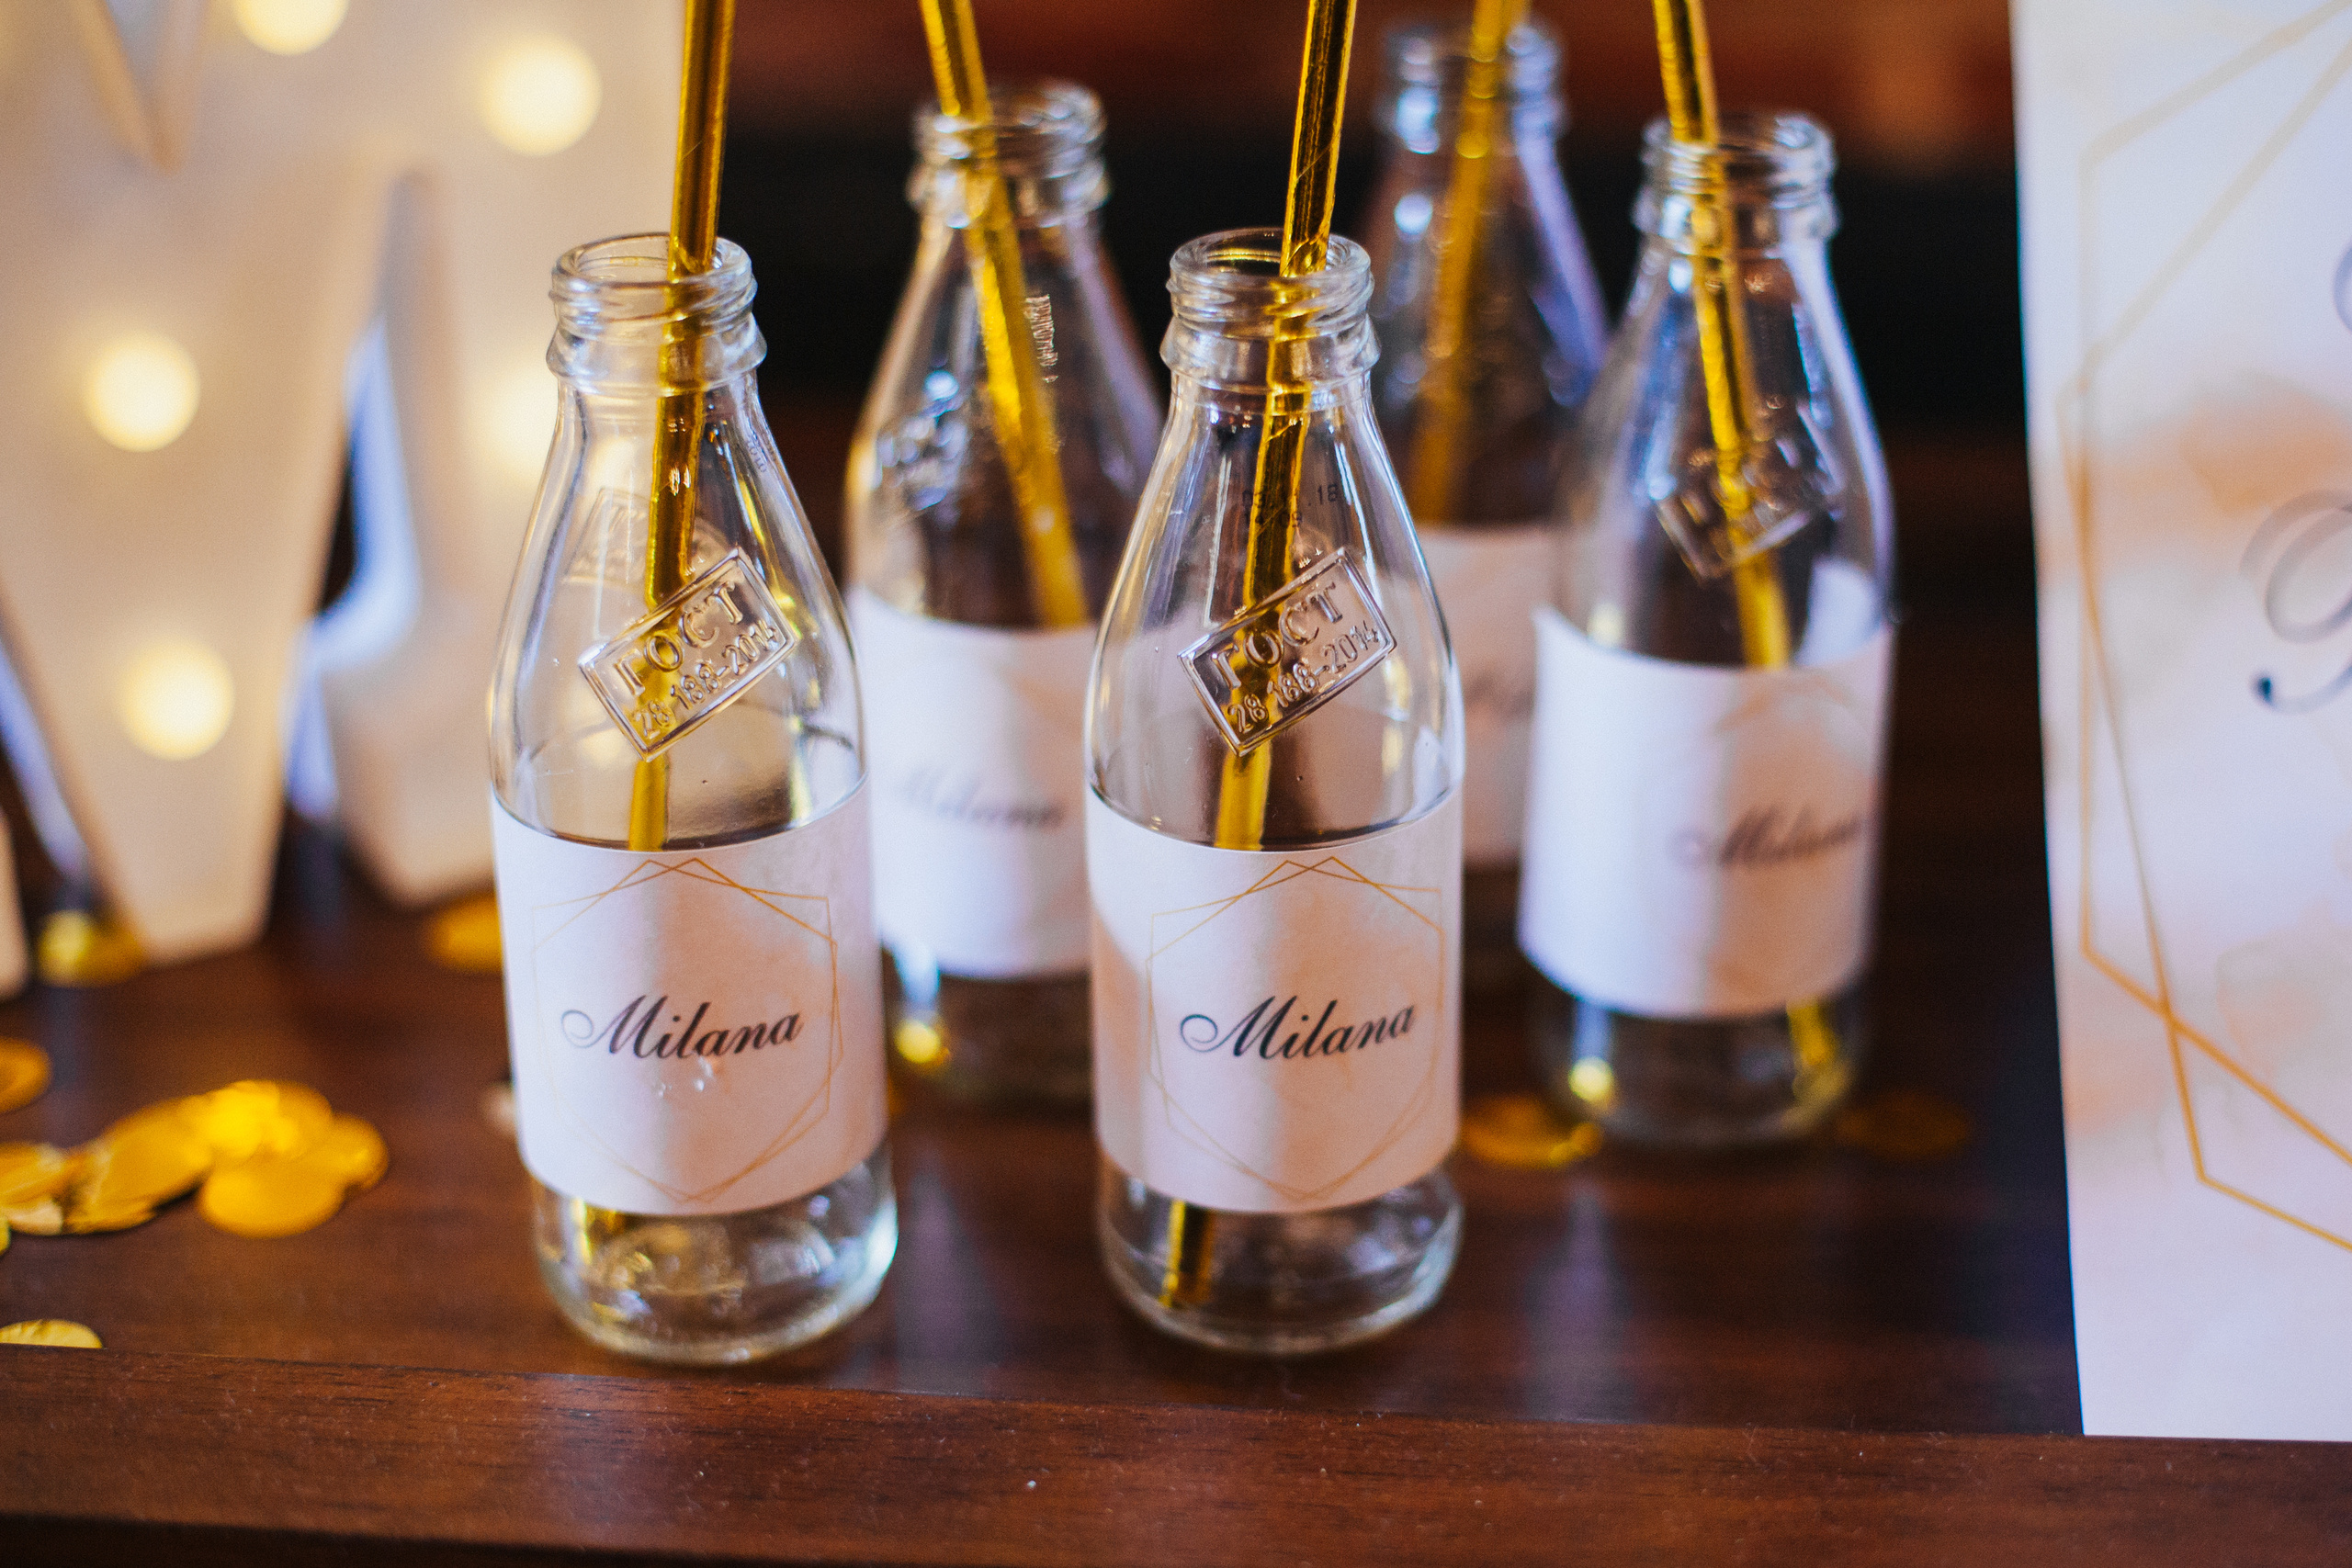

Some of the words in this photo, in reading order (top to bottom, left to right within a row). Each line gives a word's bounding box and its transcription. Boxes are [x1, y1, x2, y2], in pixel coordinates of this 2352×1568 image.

[613, 581, 743, 696] ГОСТ
[1210, 581, 1344, 689] ГОСТ
[560, 994, 805, 1059] Milana
[1179, 994, 1417, 1060] Milana
